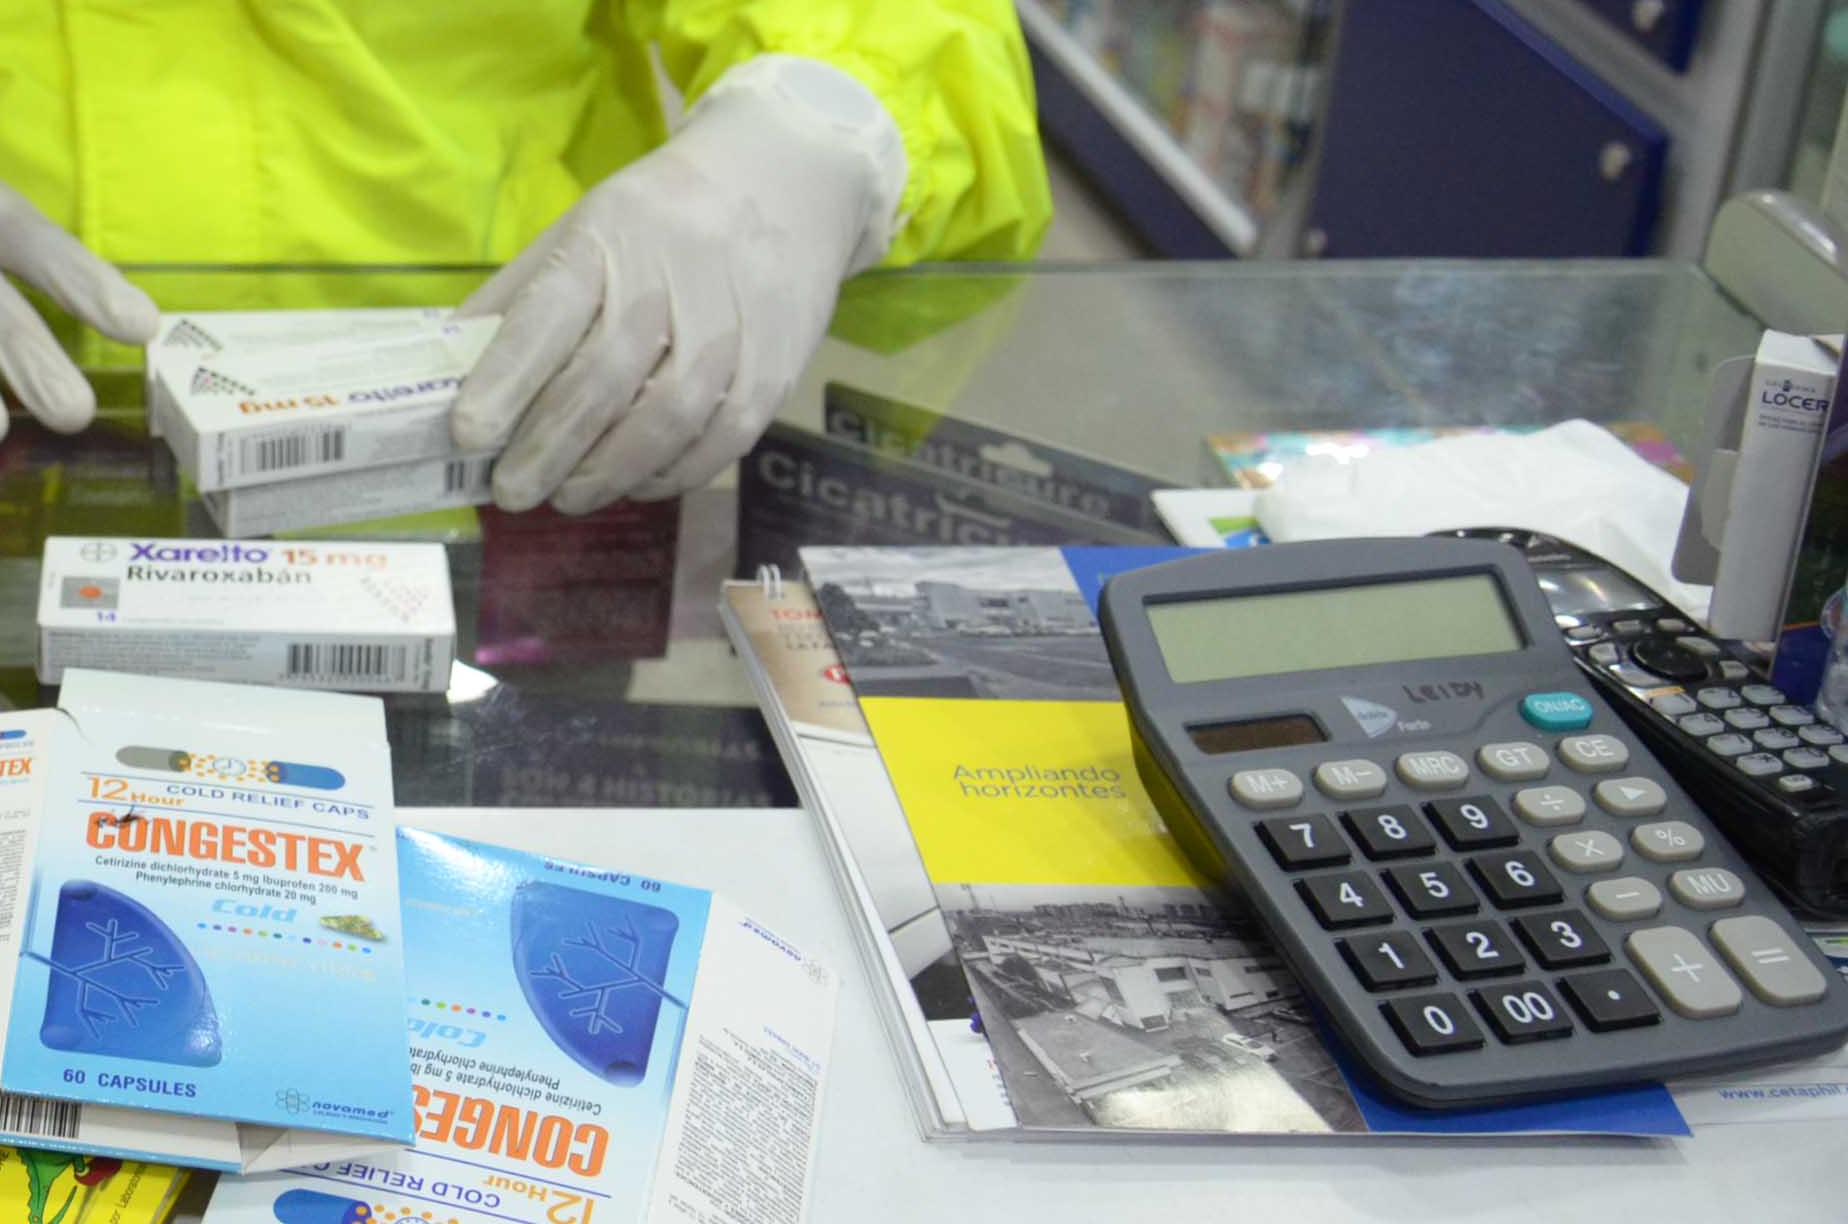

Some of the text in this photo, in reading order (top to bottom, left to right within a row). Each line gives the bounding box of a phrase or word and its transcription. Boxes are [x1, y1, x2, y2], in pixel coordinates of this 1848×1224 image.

[129, 542, 388, 569] Xarelto 15 mg
[127, 565, 312, 585] Rivaroxabán
[1495, 747, 1534, 768] GT
[1574, 737, 1613, 759] CE
[953, 764, 1121, 784] Ampliando
[1408, 755, 1460, 777] MRC
[85, 775, 185, 807] 12 Hour
[960, 779, 1127, 800] horizontes
[1246, 775, 1290, 794] M+
[166, 783, 371, 821] COLD RELIEF CAPS
[1377, 814, 1408, 840] 8
[1460, 803, 1490, 830] 9
[84, 810, 367, 883] CONGESTEX
[1289, 822, 1315, 849] 7
[94, 854, 148, 871] Cetirizine
[149, 859, 231, 880] dichlorhydrate
[242, 873, 261, 885] mg
[262, 873, 316, 891] Ibuprofen
[340, 887, 359, 900] mg
[135, 870, 317, 905] Phenylephrine chlorhydrate 20 mg
[1418, 871, 1450, 899] 5
[1504, 860, 1536, 888] 6
[1688, 872, 1732, 896] MU
[1339, 881, 1364, 908] 4
[211, 897, 298, 923] Cold
[1465, 930, 1500, 960] 2
[1550, 920, 1583, 949] 3
[1377, 941, 1406, 970] 1
[1422, 1004, 1455, 1036] 0
[1502, 990, 1555, 1025] 00
[62, 1068, 199, 1098] 60 CAPSULES
[423, 1063, 444, 1080] mg
[477, 1060, 561, 1091] Phenylephrine
[455, 1070, 543, 1103] dichlorhydrate
[311, 1099, 390, 1121] novamed
[544, 1091, 603, 1117] Cetirizine
[336, 1162, 502, 1209] COLD RELIEF
[483, 1174, 549, 1200] Hour
